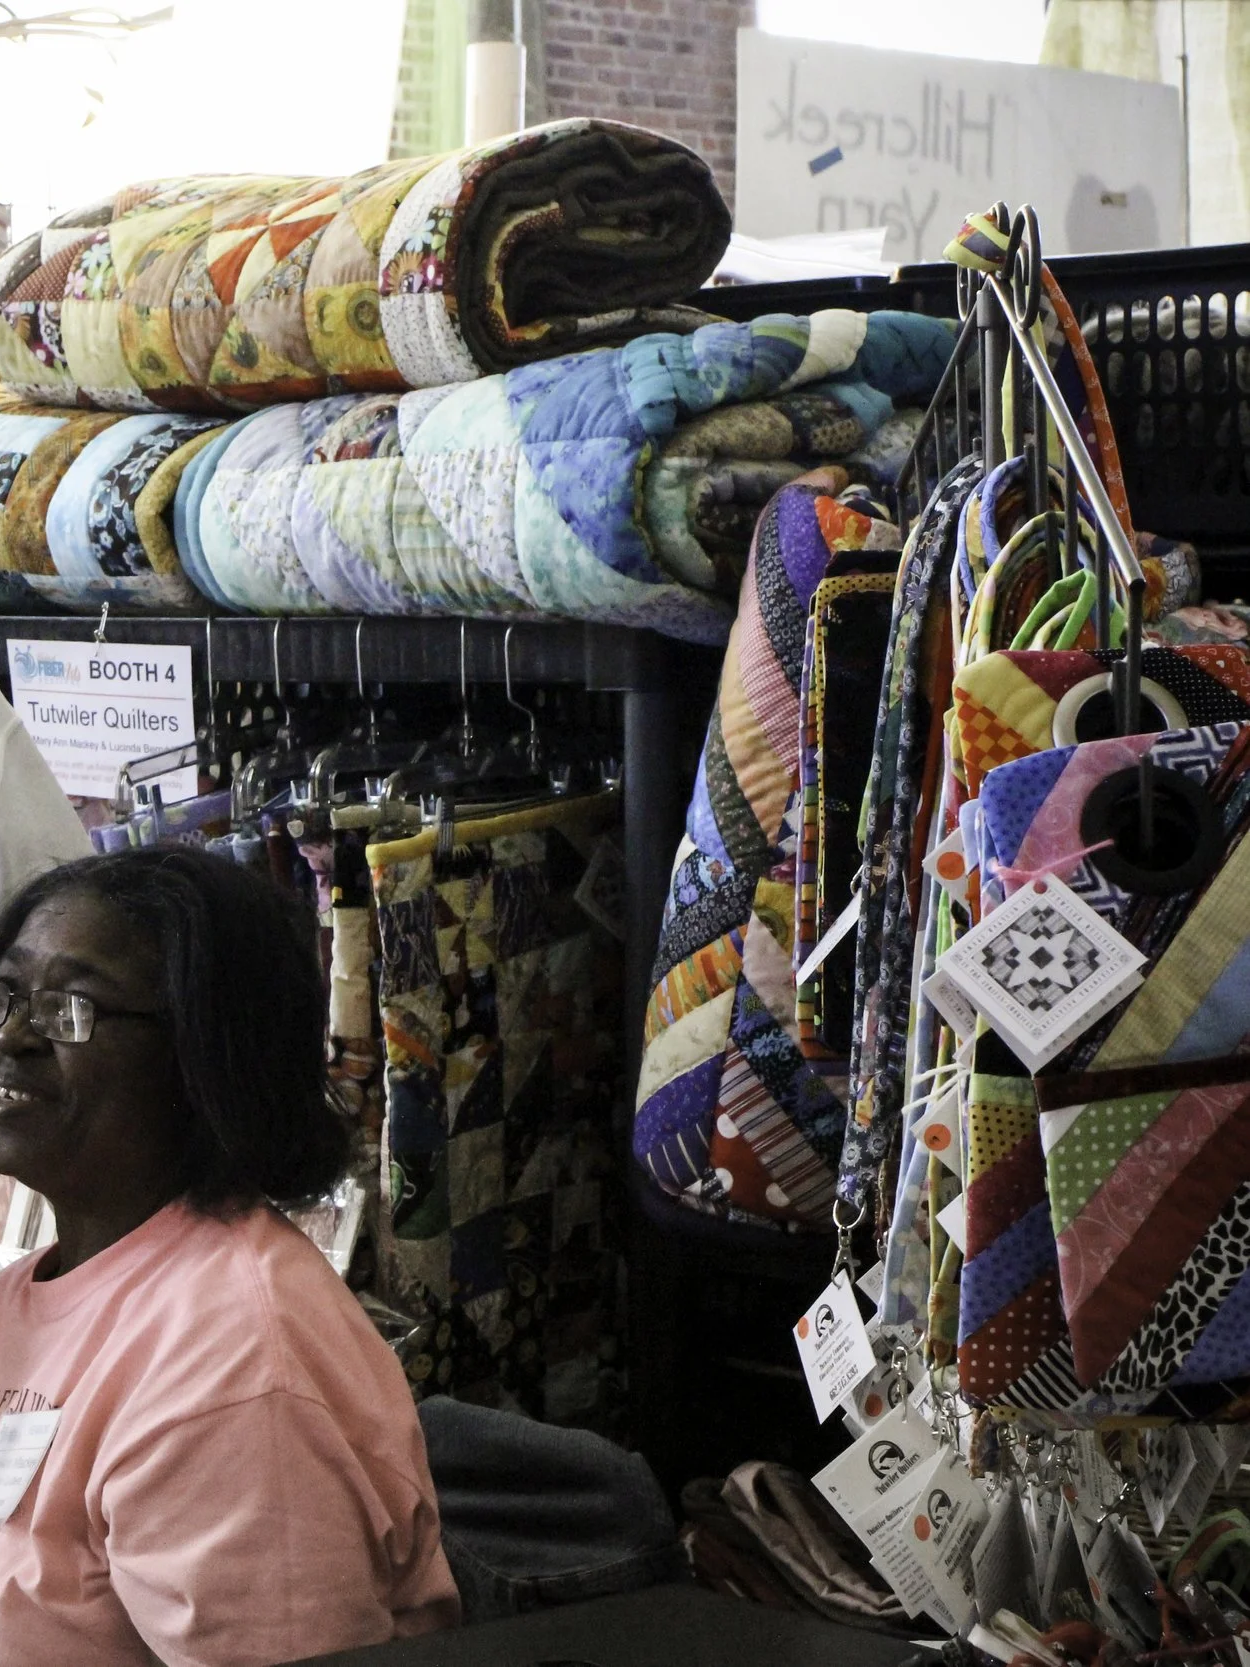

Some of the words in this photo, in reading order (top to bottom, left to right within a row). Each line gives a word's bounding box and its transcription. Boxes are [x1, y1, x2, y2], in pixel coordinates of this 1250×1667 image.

[89, 660, 158, 682] BOOTH
[165, 664, 176, 683] 4
[28, 701, 98, 727] Tutwiler
[103, 706, 179, 732] Quilters
